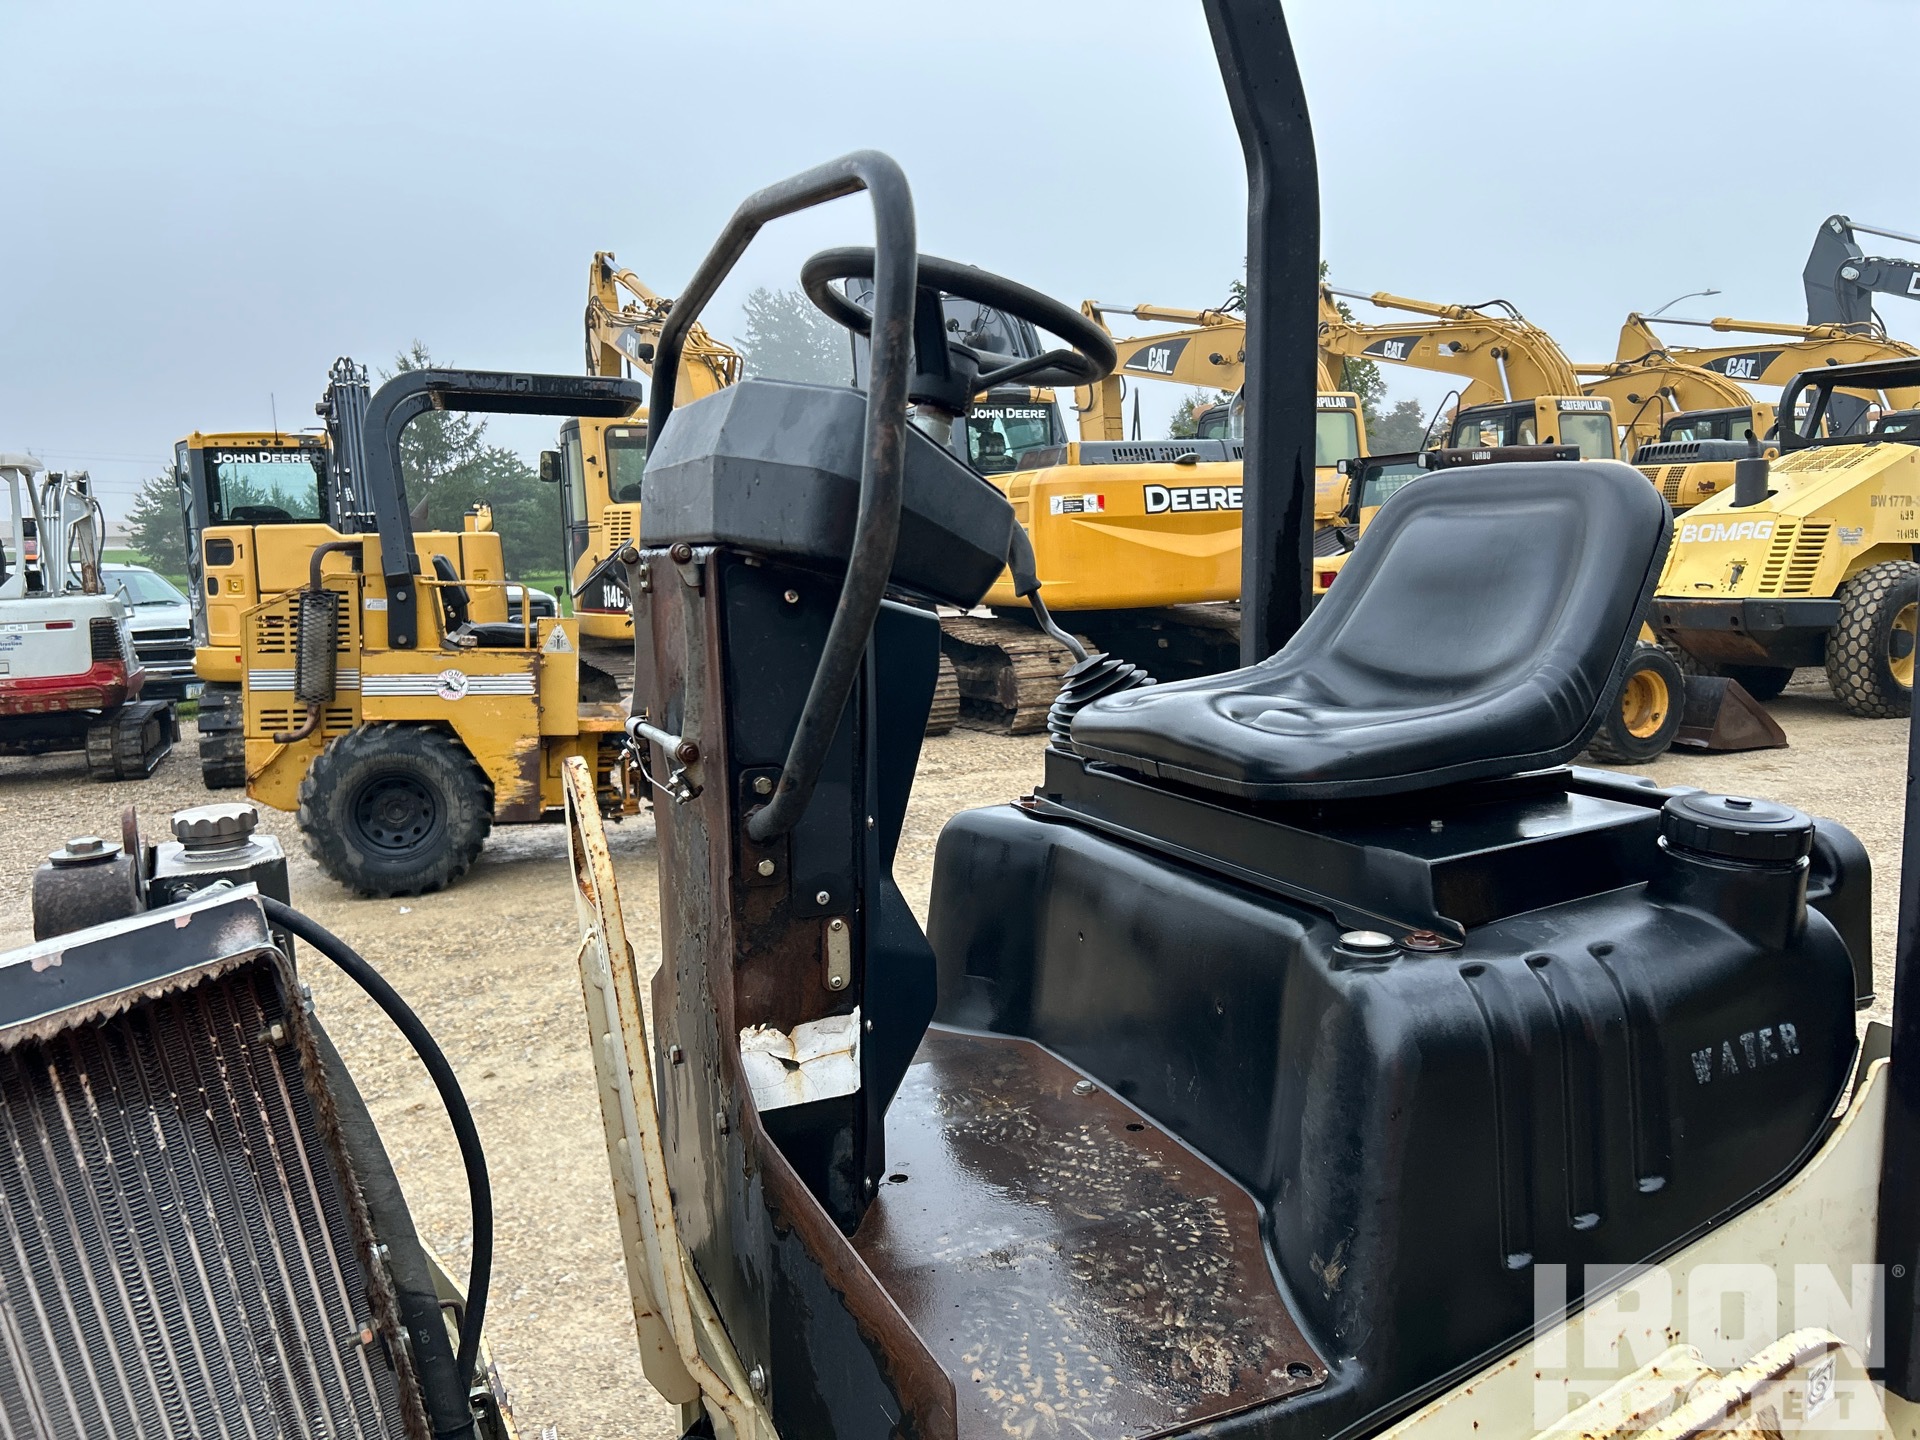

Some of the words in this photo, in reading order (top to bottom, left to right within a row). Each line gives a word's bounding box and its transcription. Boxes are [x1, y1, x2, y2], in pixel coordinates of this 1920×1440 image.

[1147, 347, 1170, 372] CAT
[1384, 340, 1405, 359] CAT
[1725, 357, 1756, 379] CAT
[970, 407, 1003, 419] JOHN
[1005, 407, 1046, 419] DEERE
[1561, 400, 1603, 410] CATERPILLAR
[213, 452, 256, 464] JOHN
[259, 452, 310, 464] DEERE
[1144, 485, 1244, 513] DEERE
[1870, 494, 1887, 507] BW
[1680, 520, 1775, 543] BOMAG
[1691, 1023, 1800, 1084] WATER
